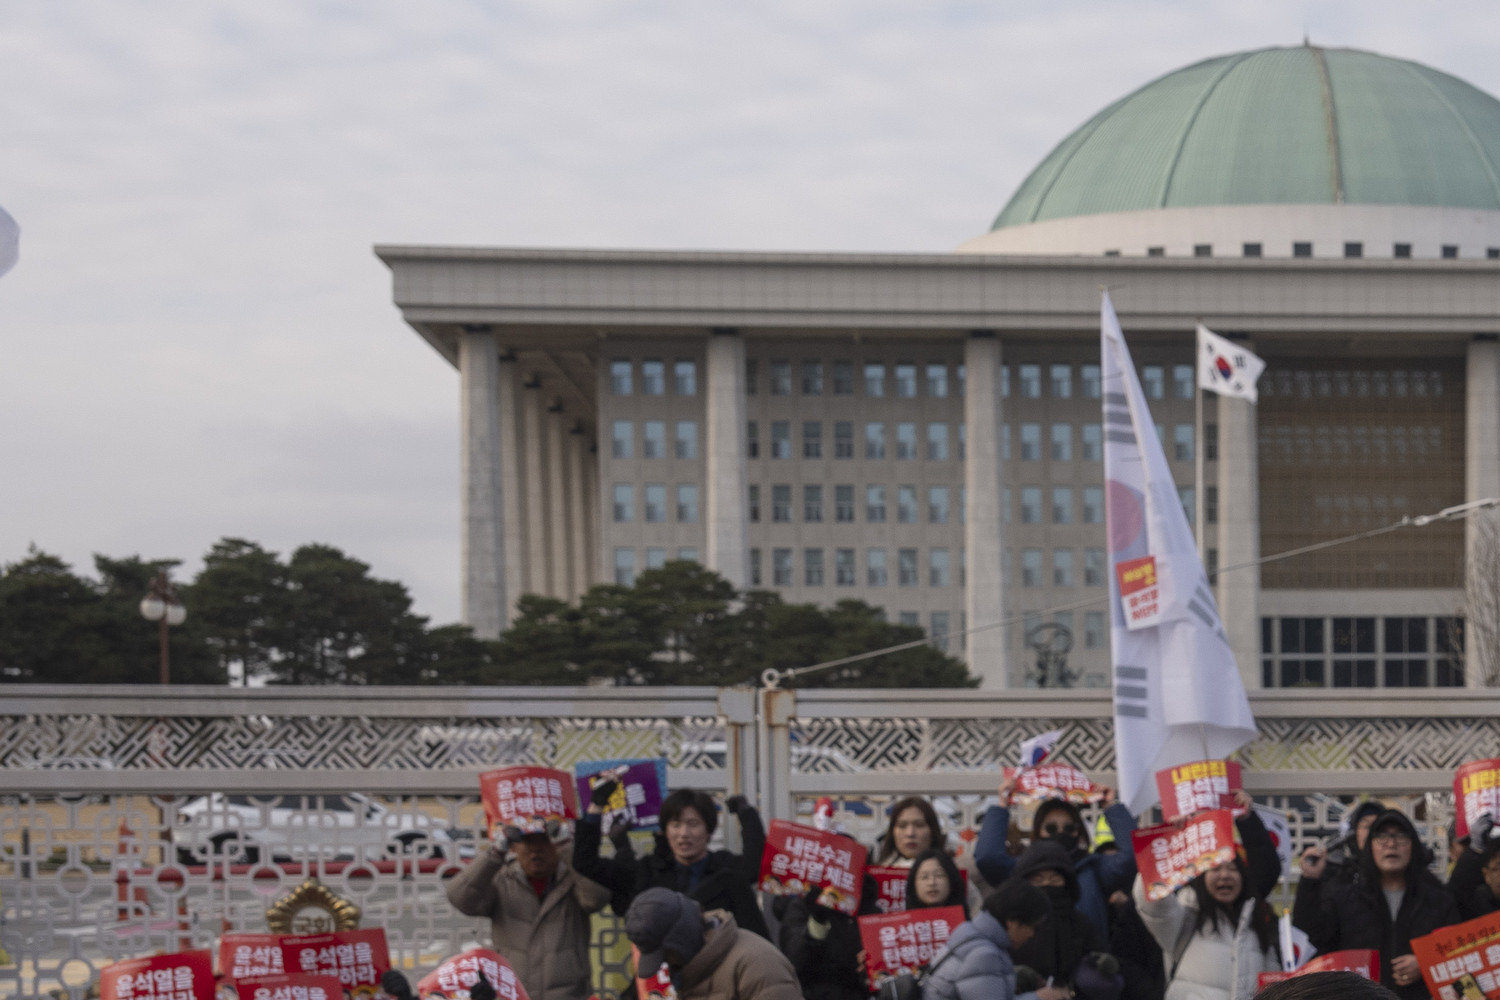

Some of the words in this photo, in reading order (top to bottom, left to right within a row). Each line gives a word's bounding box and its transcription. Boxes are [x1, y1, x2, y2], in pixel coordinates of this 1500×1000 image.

[786, 835, 852, 871] 내란수괴
[772, 853, 817, 884] 윤석열
[818, 866, 856, 893] 체포
[879, 917, 950, 949] 윤석열을
[299, 942, 374, 970] 윤석열을
[116, 965, 195, 995] 윤석열을
